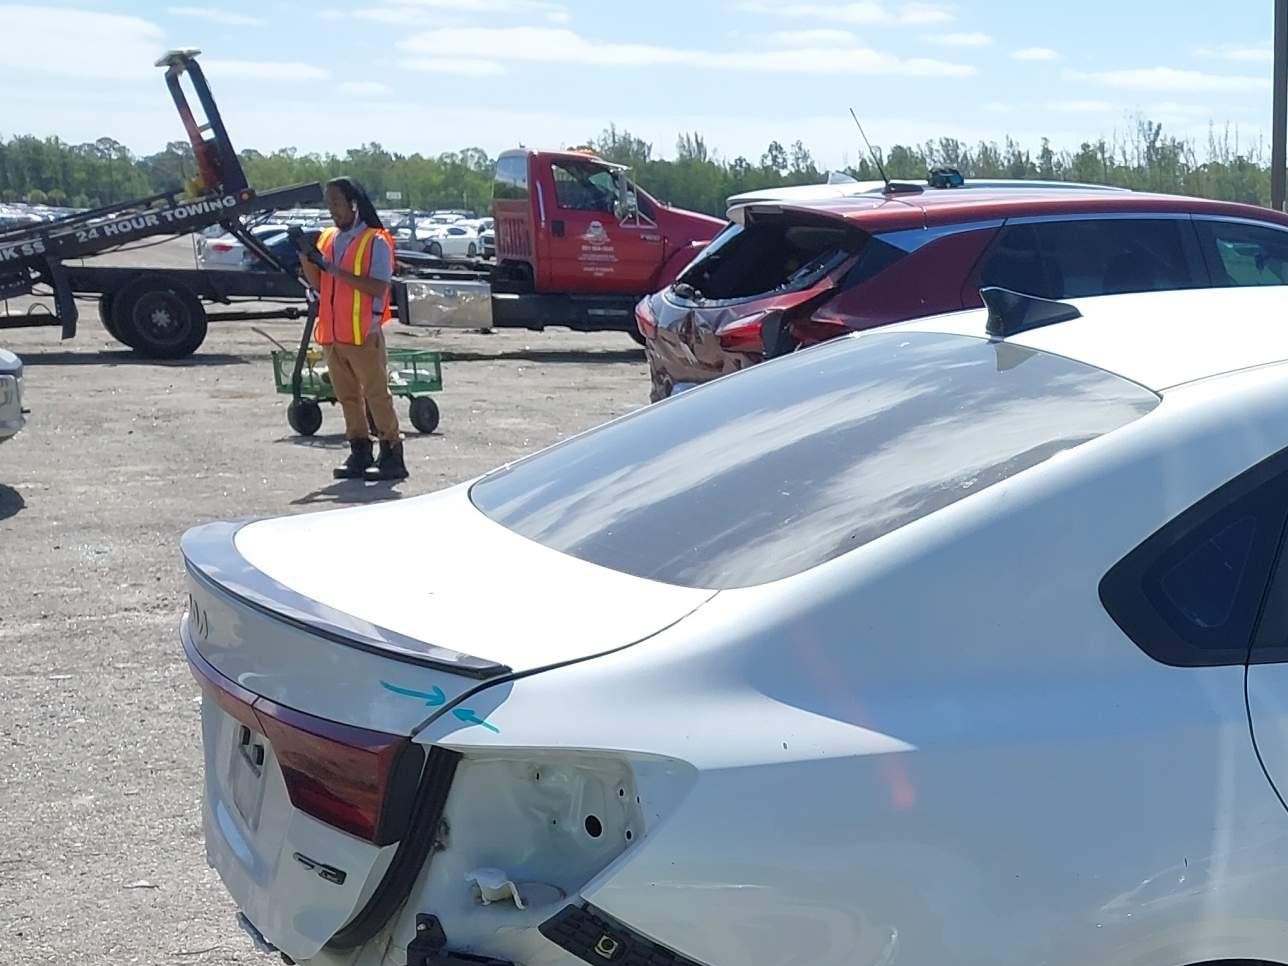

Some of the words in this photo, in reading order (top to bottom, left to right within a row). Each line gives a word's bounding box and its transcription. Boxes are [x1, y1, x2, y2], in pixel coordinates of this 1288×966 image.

[75, 230, 100, 243] 24
[103, 213, 160, 237] HOUR
[160, 195, 236, 221] TOWING
